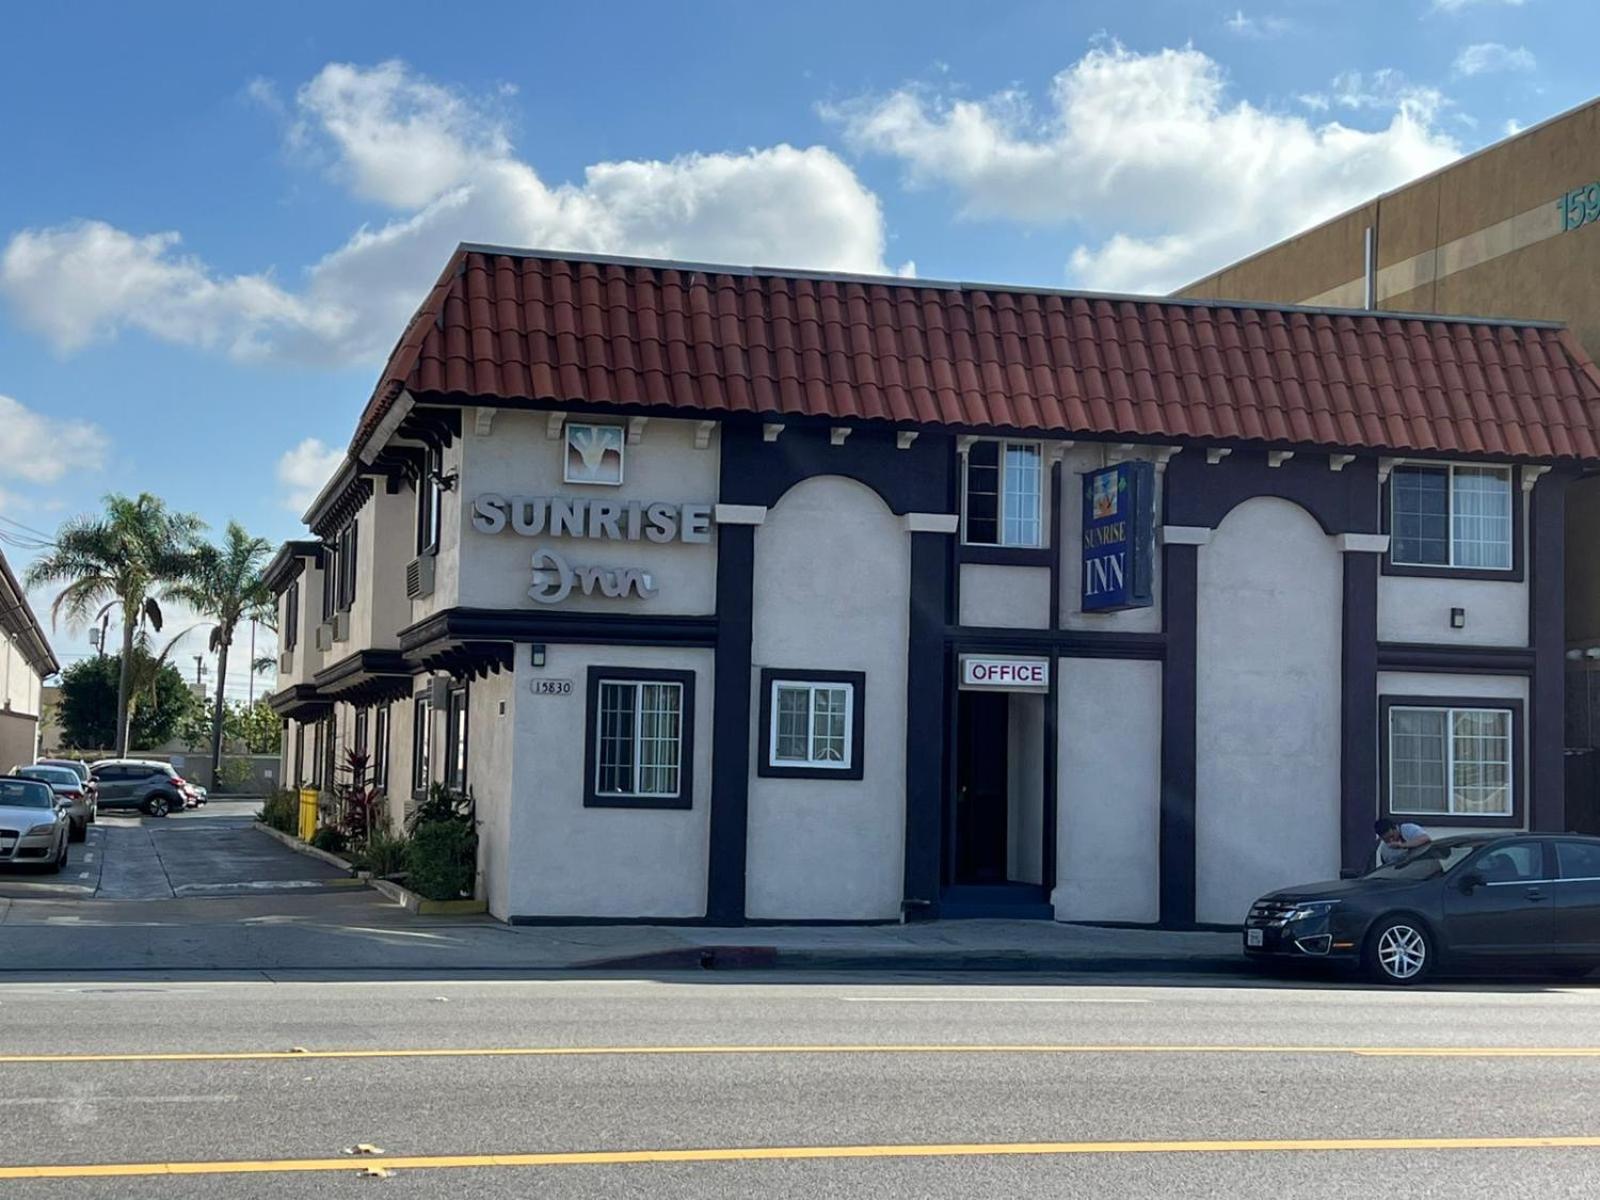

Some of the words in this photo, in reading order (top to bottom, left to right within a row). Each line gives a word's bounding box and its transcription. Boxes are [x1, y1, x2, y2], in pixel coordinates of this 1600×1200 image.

[472, 493, 712, 544] SUNRISE
[1084, 521, 1126, 549] SUNRISE
[528, 548, 659, 604] Inn
[1085, 552, 1126, 596] INN
[535, 681, 571, 694] 15830
[972, 664, 1042, 681] OFFICE
